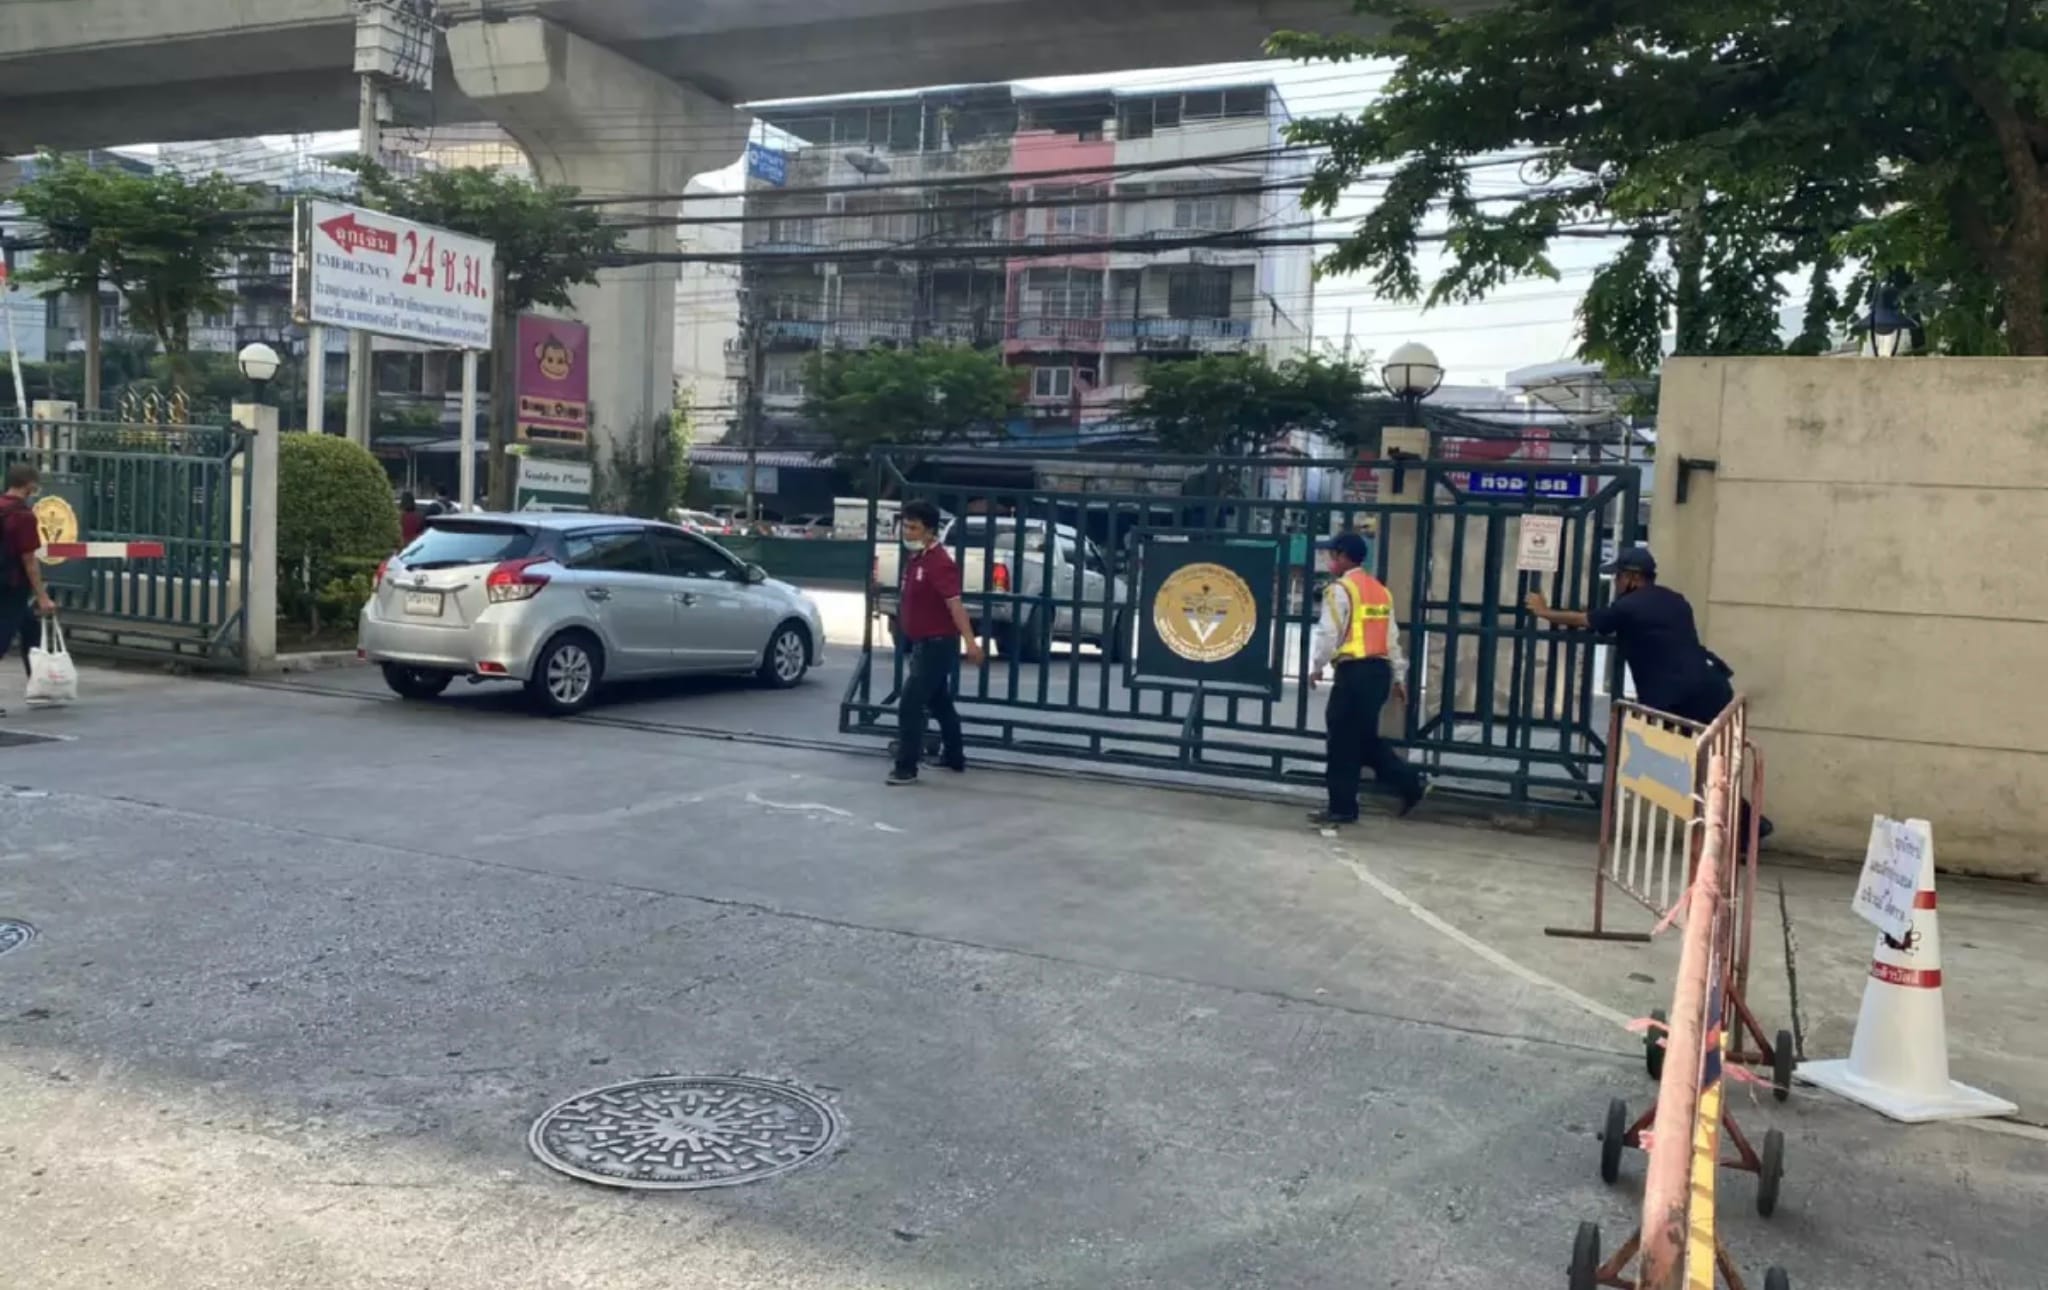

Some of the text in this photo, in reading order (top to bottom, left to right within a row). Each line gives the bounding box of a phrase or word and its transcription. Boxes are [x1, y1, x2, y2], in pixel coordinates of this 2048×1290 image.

[335, 229, 389, 250] ฉุกเฉิน
[316, 253, 391, 280] EMERGENCY
[402, 231, 435, 288] 24
